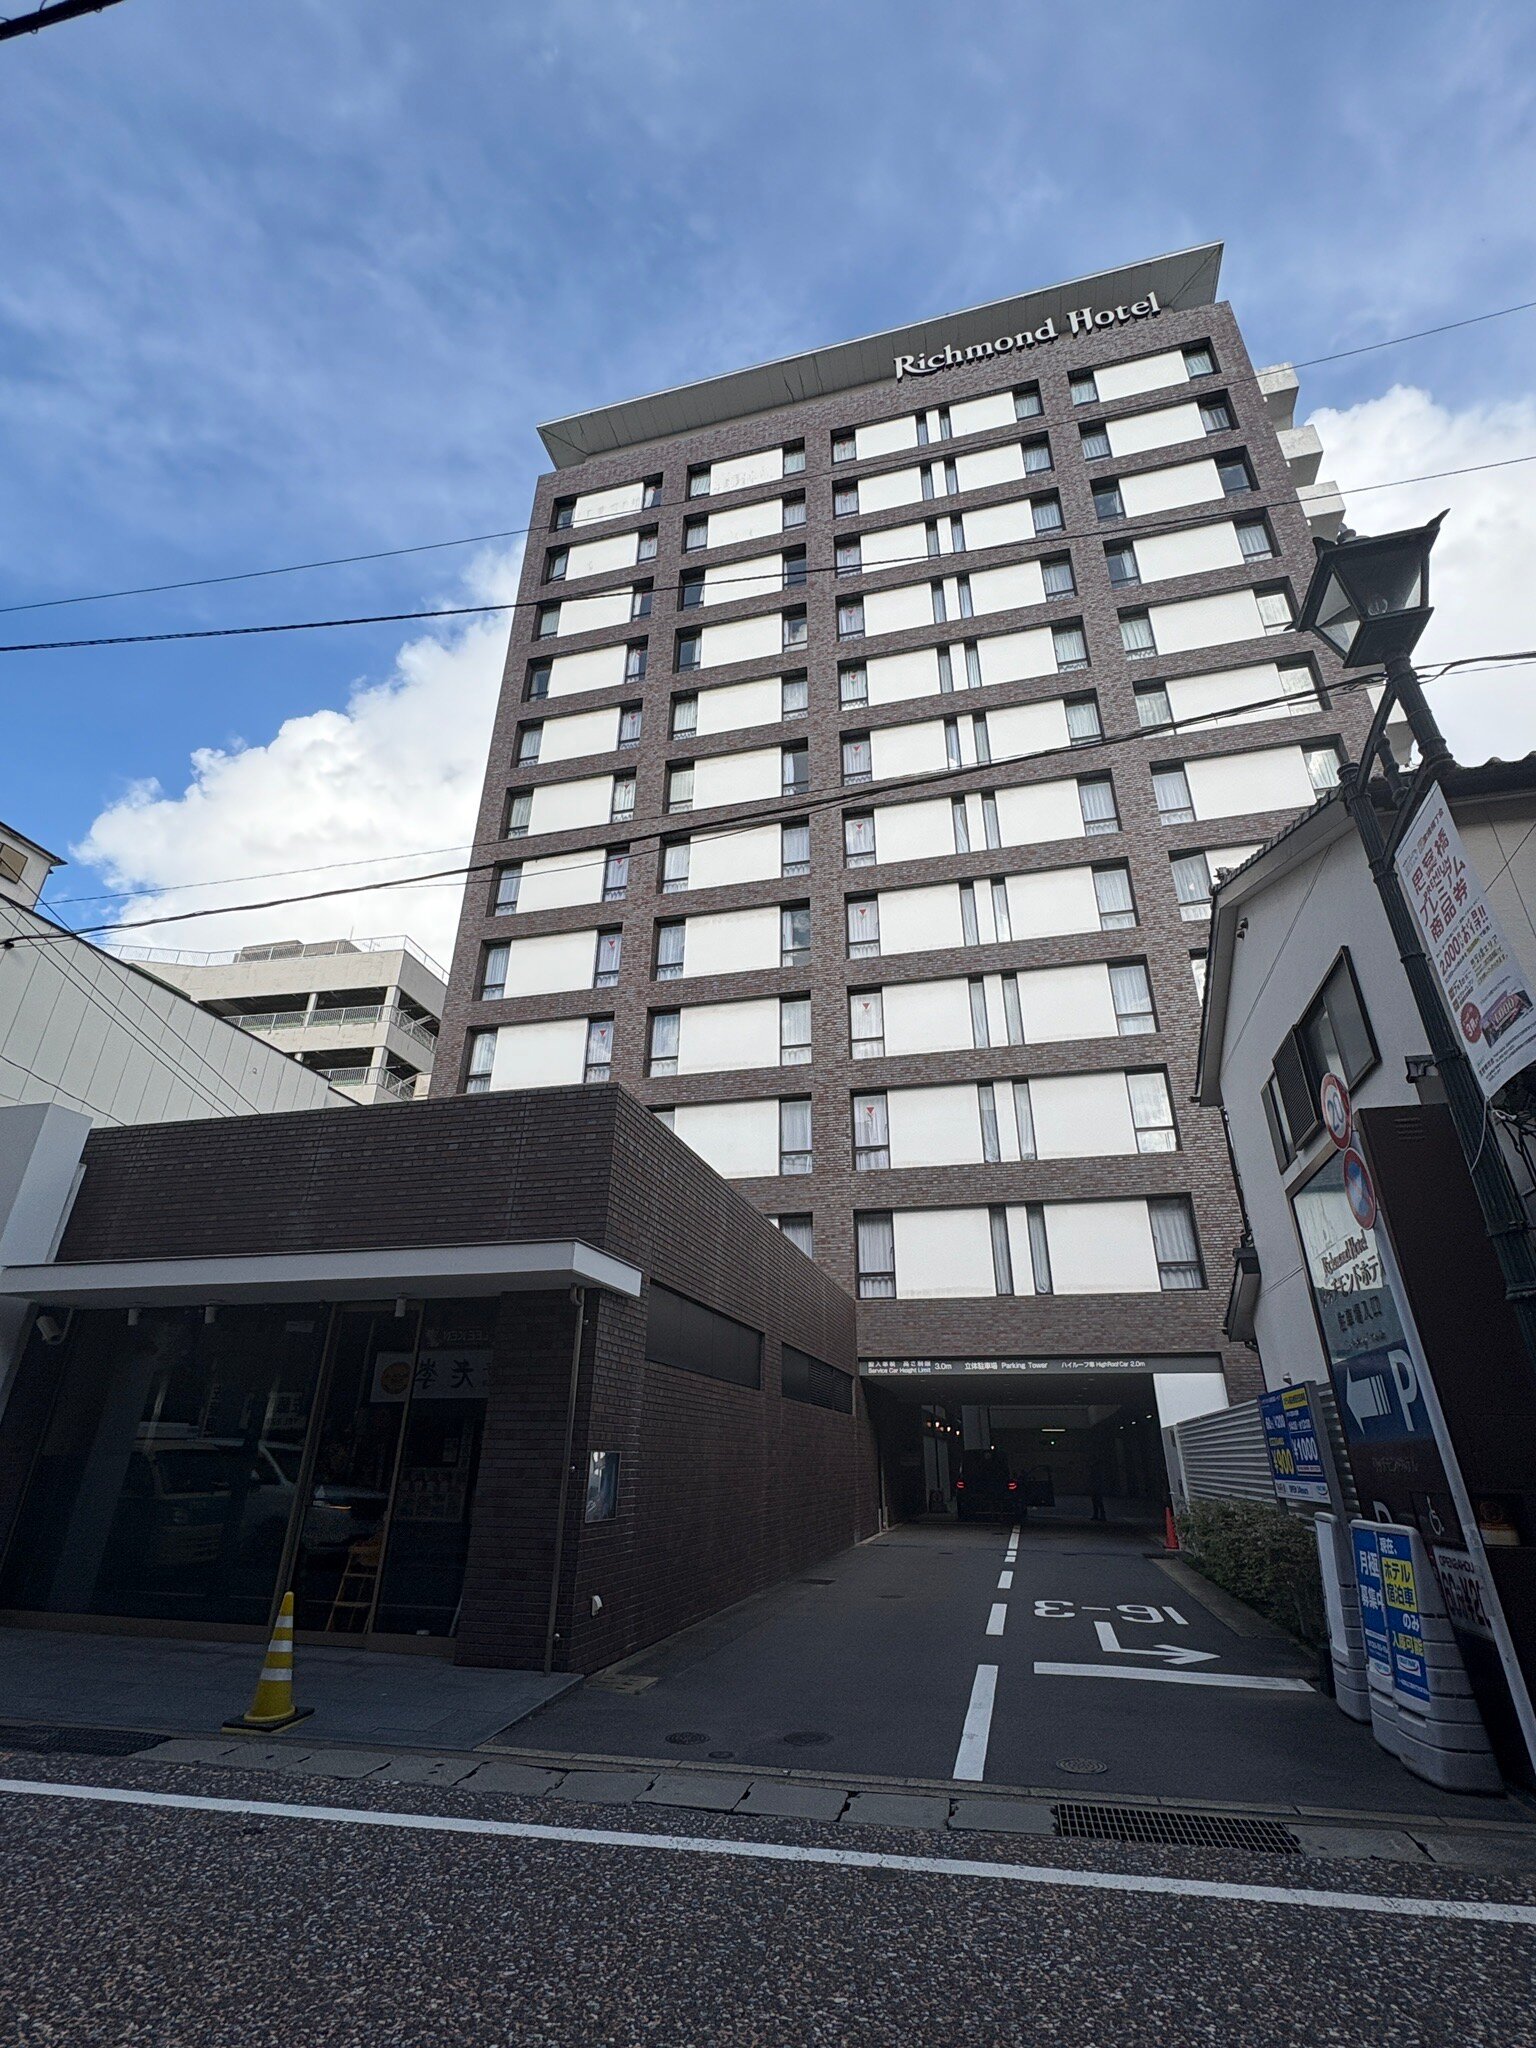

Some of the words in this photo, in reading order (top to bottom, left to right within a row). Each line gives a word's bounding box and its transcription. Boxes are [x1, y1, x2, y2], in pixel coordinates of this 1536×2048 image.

[893, 318, 1058, 380] Richmond
[1067, 291, 1161, 334] Hotel
[1411, 827, 1450, 896] 思案橋
[1420, 856, 1466, 926] プレミアム
[1423, 855, 1452, 902] PREMIUM
[1430, 878, 1468, 943] 商品券
[1327, 1092, 1344, 1131] 20
[899, 1366, 917, 1375] Height
[934, 1362, 952, 1370] 3.0m
[964, 1362, 998, 1370] 立体駐車場
[1001, 1362, 1027, 1370] Parking
[1027, 1361, 1048, 1369] Tower
[1387, 1348, 1418, 1432] P
[1271, 1449, 1295, 1475] ¥900
[1292, 1437, 1319, 1461] ¥1000
[1359, 1550, 1380, 1579] 月極
[1384, 1561, 1411, 1583] ホテル
[1361, 1584, 1385, 1611] 募集中
[1386, 1583, 1416, 1607] 宿泊車
[1402, 1612, 1420, 1632] のみ
